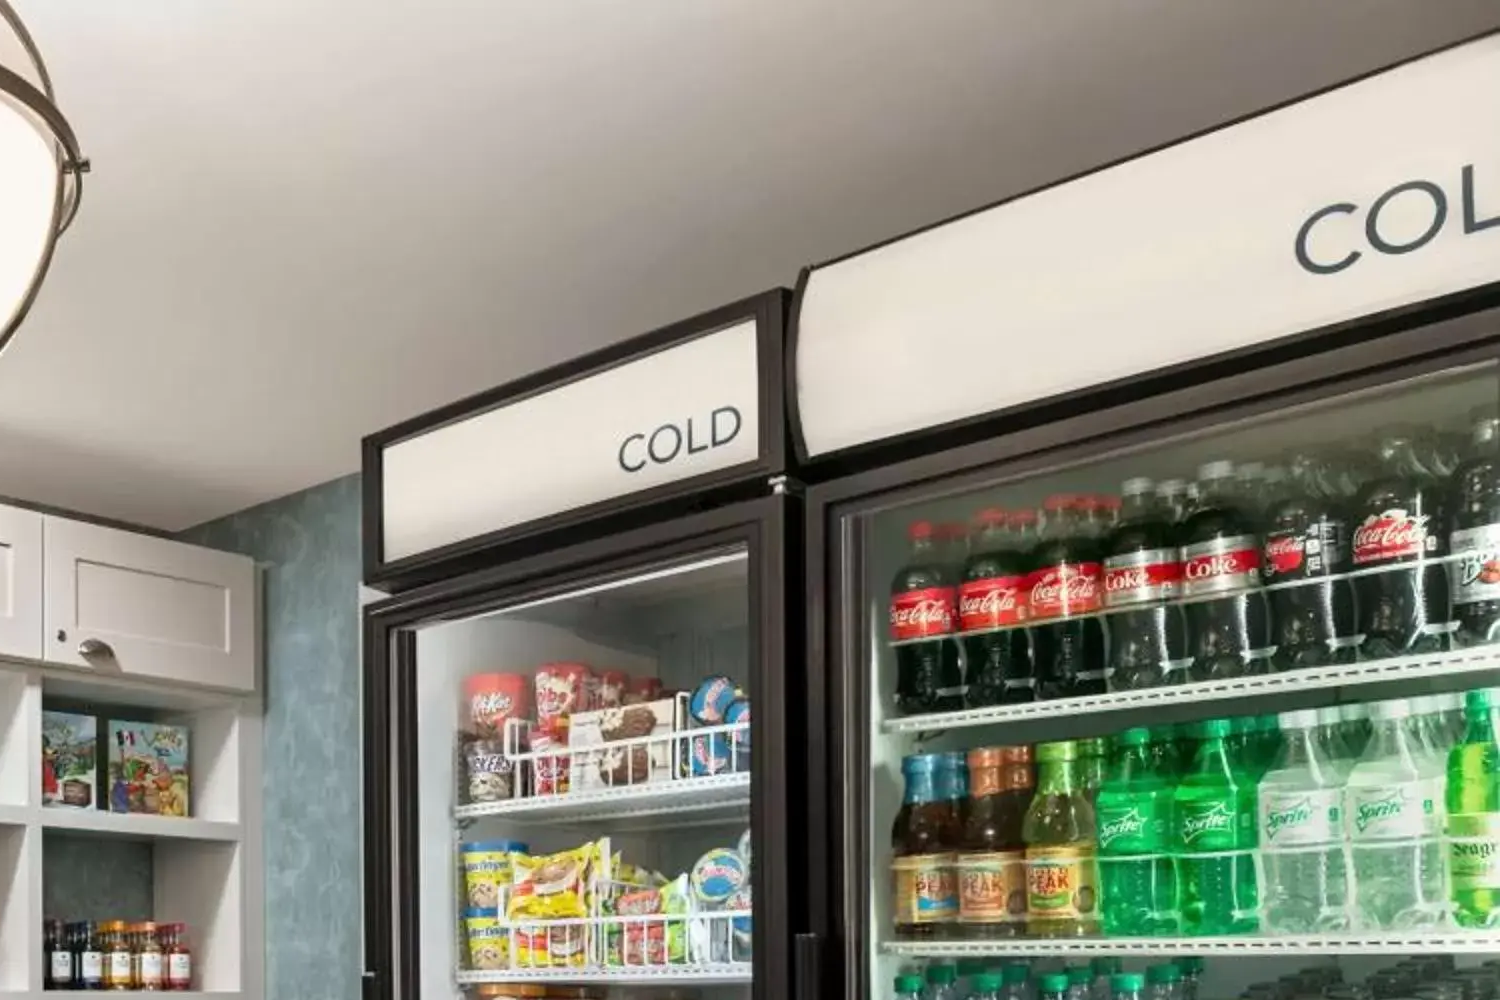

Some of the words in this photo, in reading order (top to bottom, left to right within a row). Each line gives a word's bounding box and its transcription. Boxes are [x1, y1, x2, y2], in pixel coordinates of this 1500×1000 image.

[618, 405, 742, 473] COLD
[1186, 554, 1238, 580] Coke
[1105, 570, 1150, 592] Coke
[1185, 813, 1229, 832] Sprite
